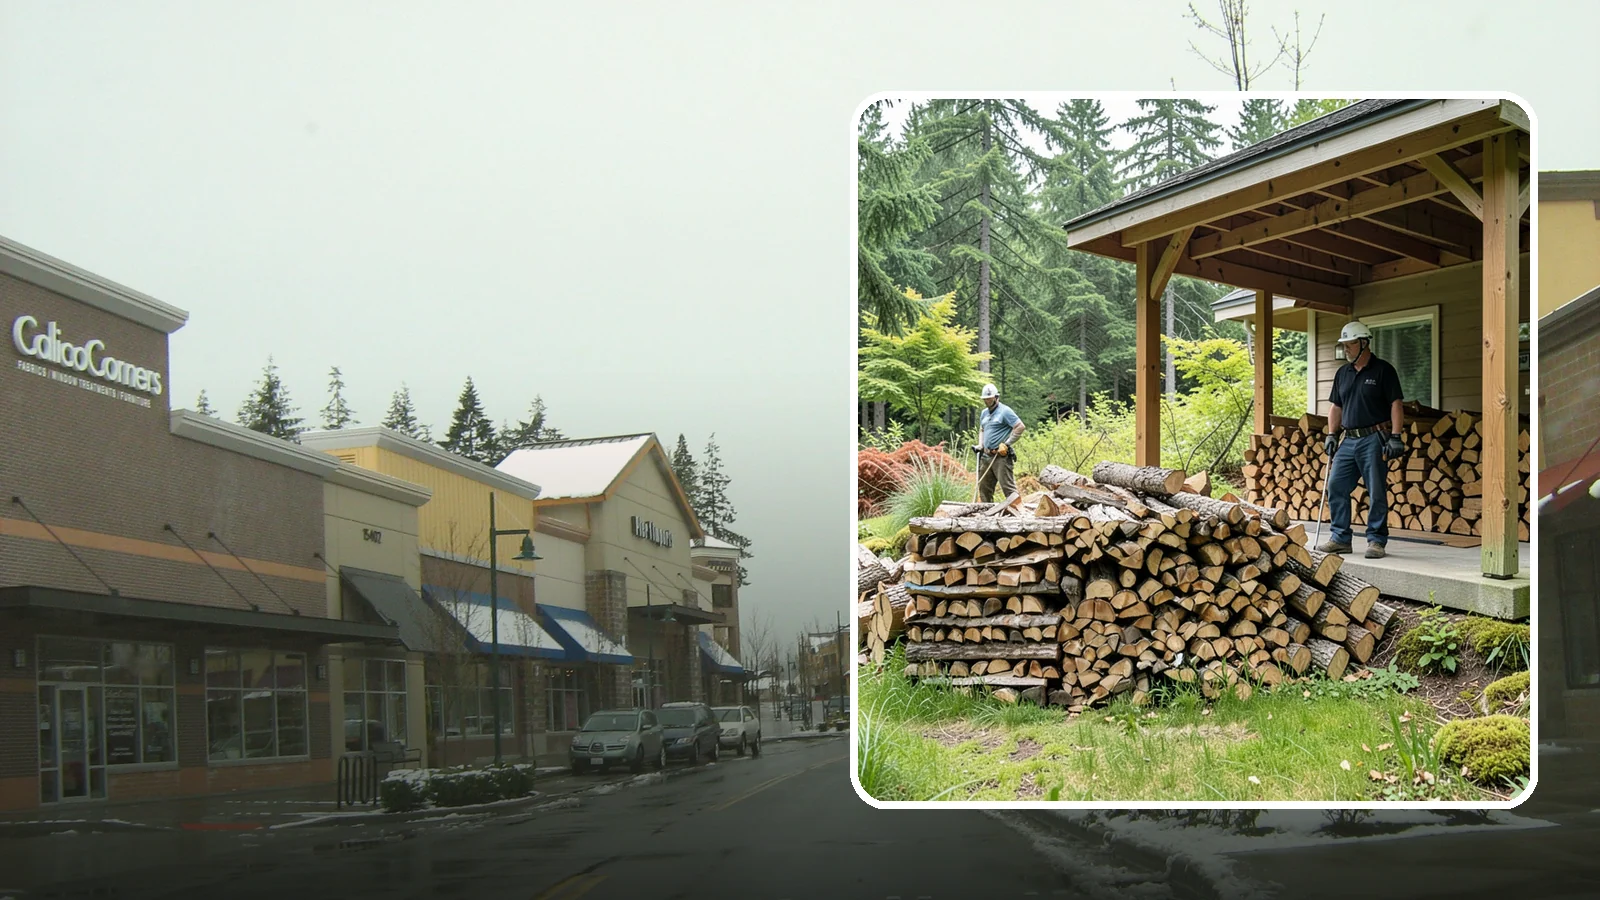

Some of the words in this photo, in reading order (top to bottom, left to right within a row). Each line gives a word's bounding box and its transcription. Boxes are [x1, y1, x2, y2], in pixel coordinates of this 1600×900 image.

[17, 360, 47, 377] FABRICS
[51, 370, 78, 386] WINDOW
[78, 378, 117, 398] TREATMENTS
[120, 391, 151, 409] FURNITURE
